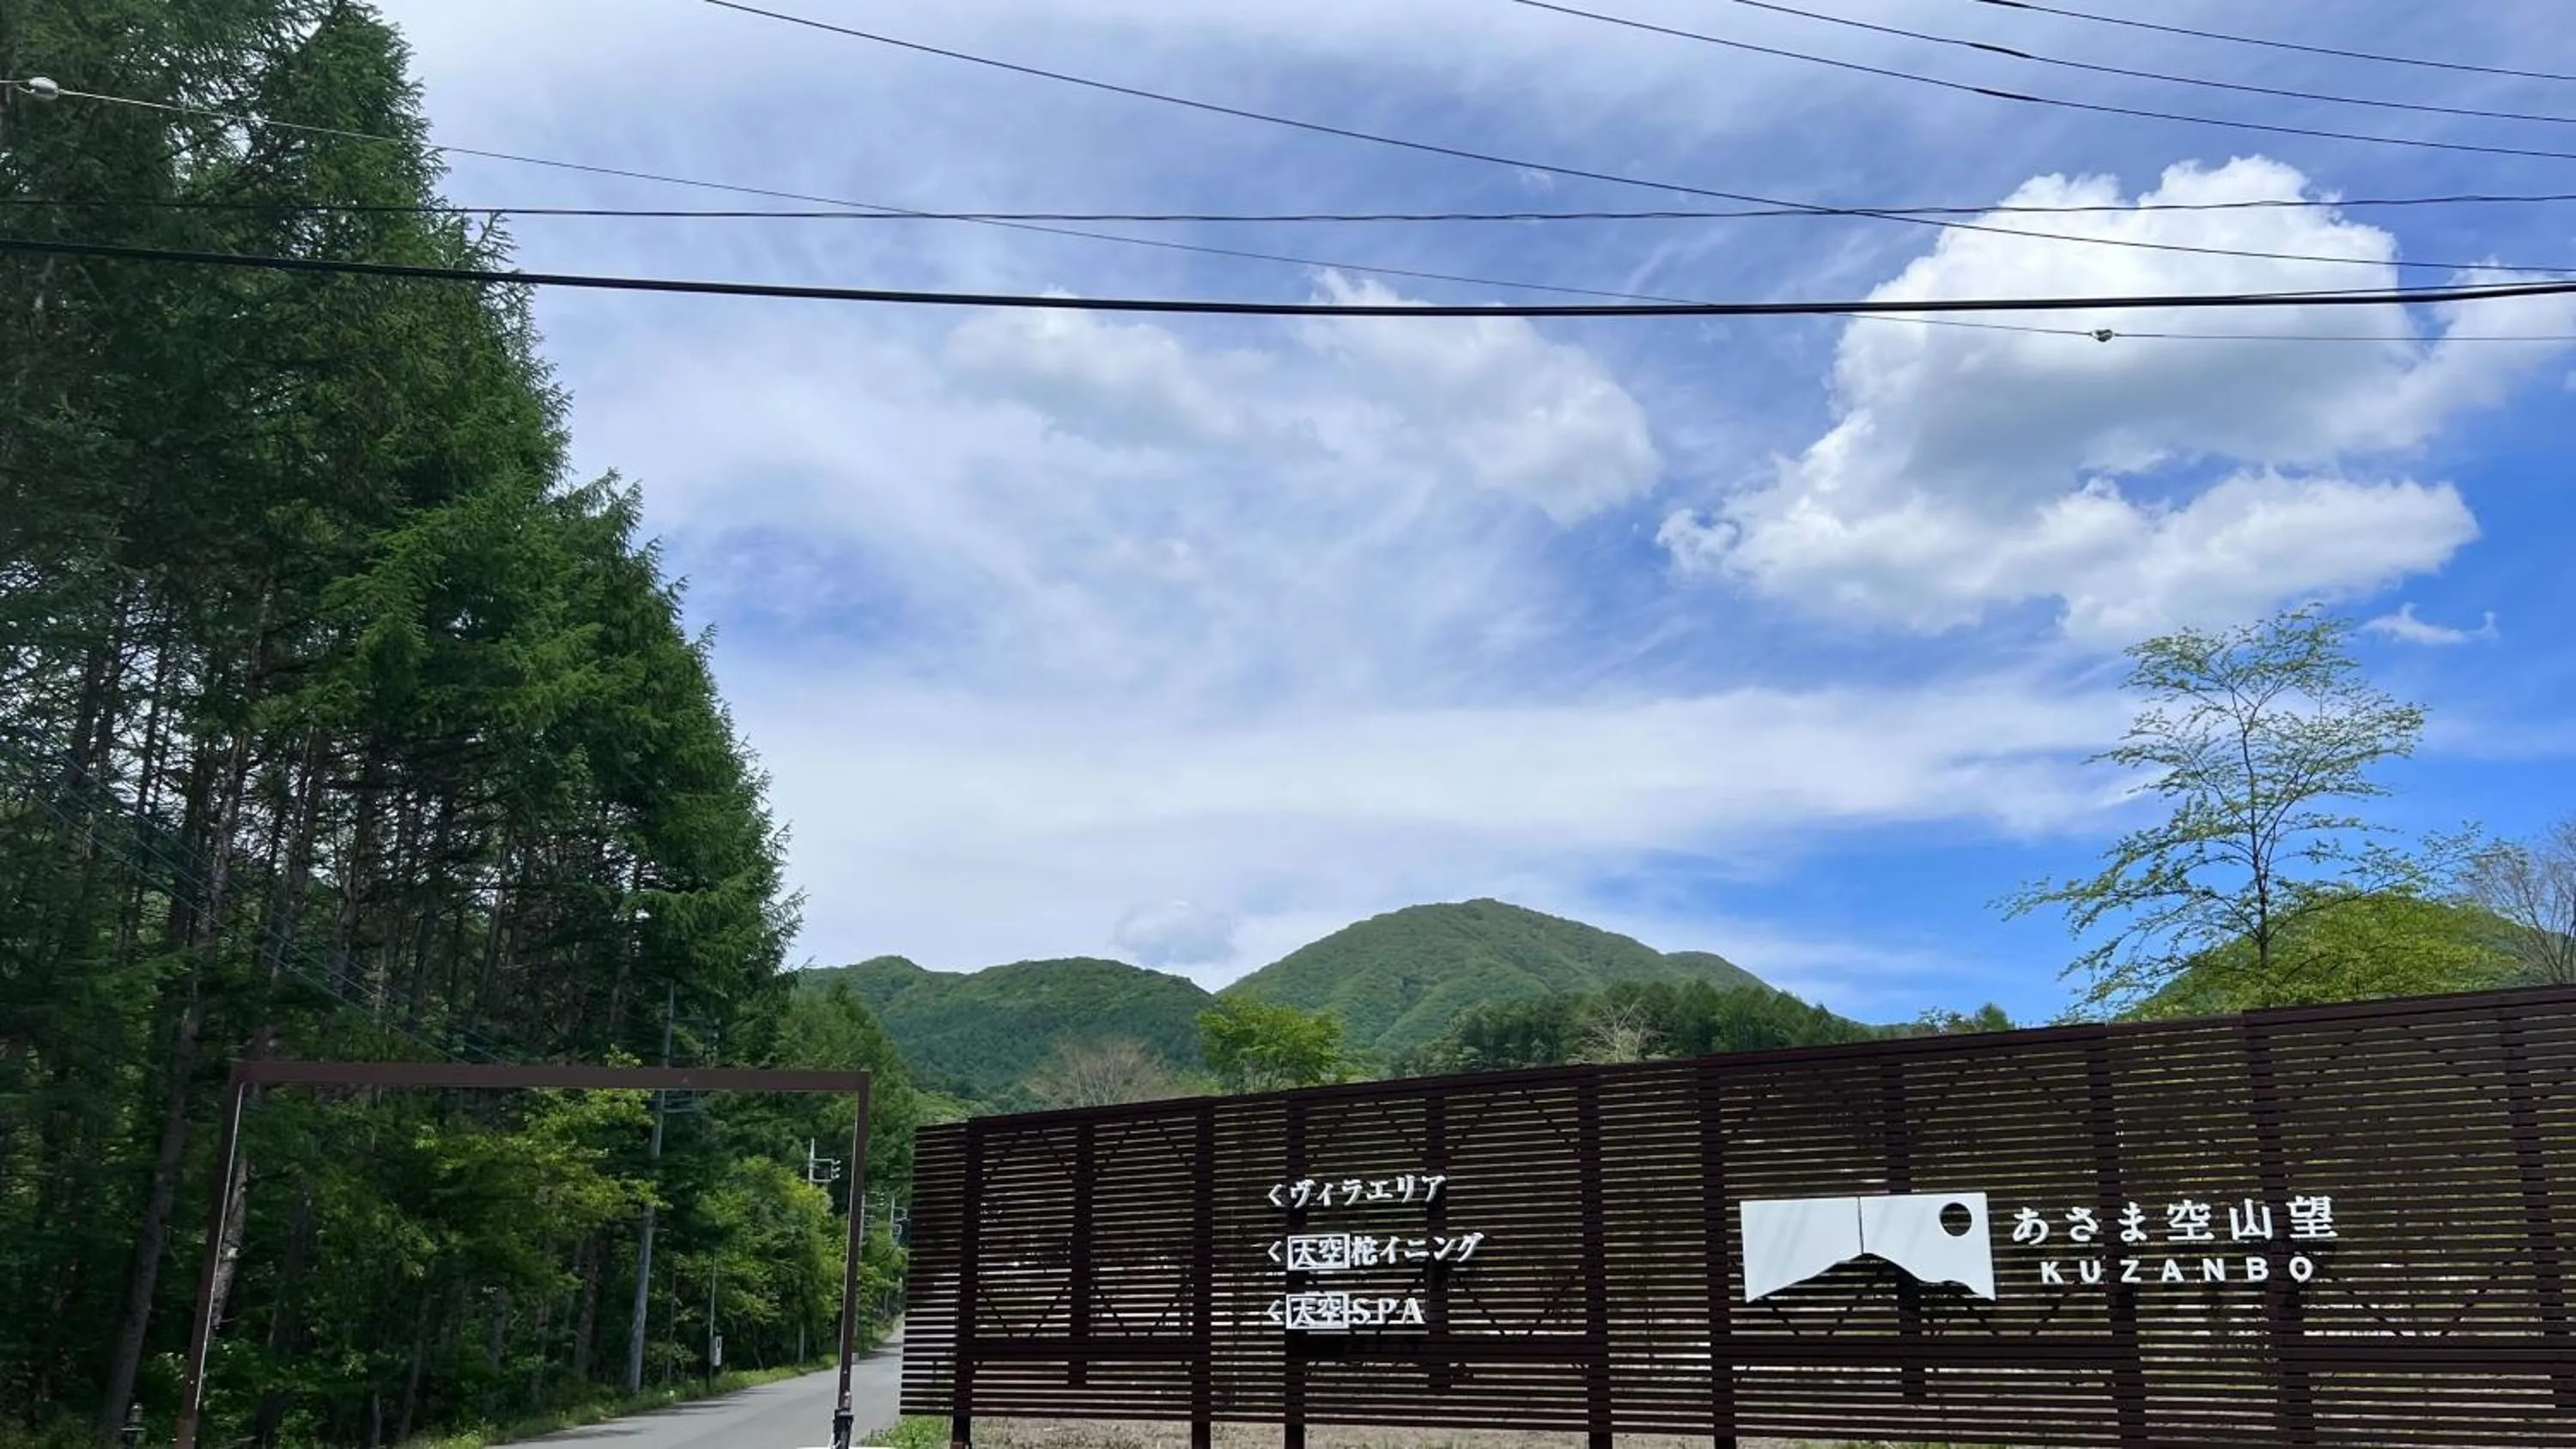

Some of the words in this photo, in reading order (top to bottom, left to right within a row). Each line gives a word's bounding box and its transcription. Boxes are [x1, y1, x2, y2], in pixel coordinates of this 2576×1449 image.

[1290, 1174, 1446, 1208] ヴィラエリア
[2012, 1195, 2338, 1245] あさま空山望
[2040, 1256, 2313, 1284] KUZANBO
